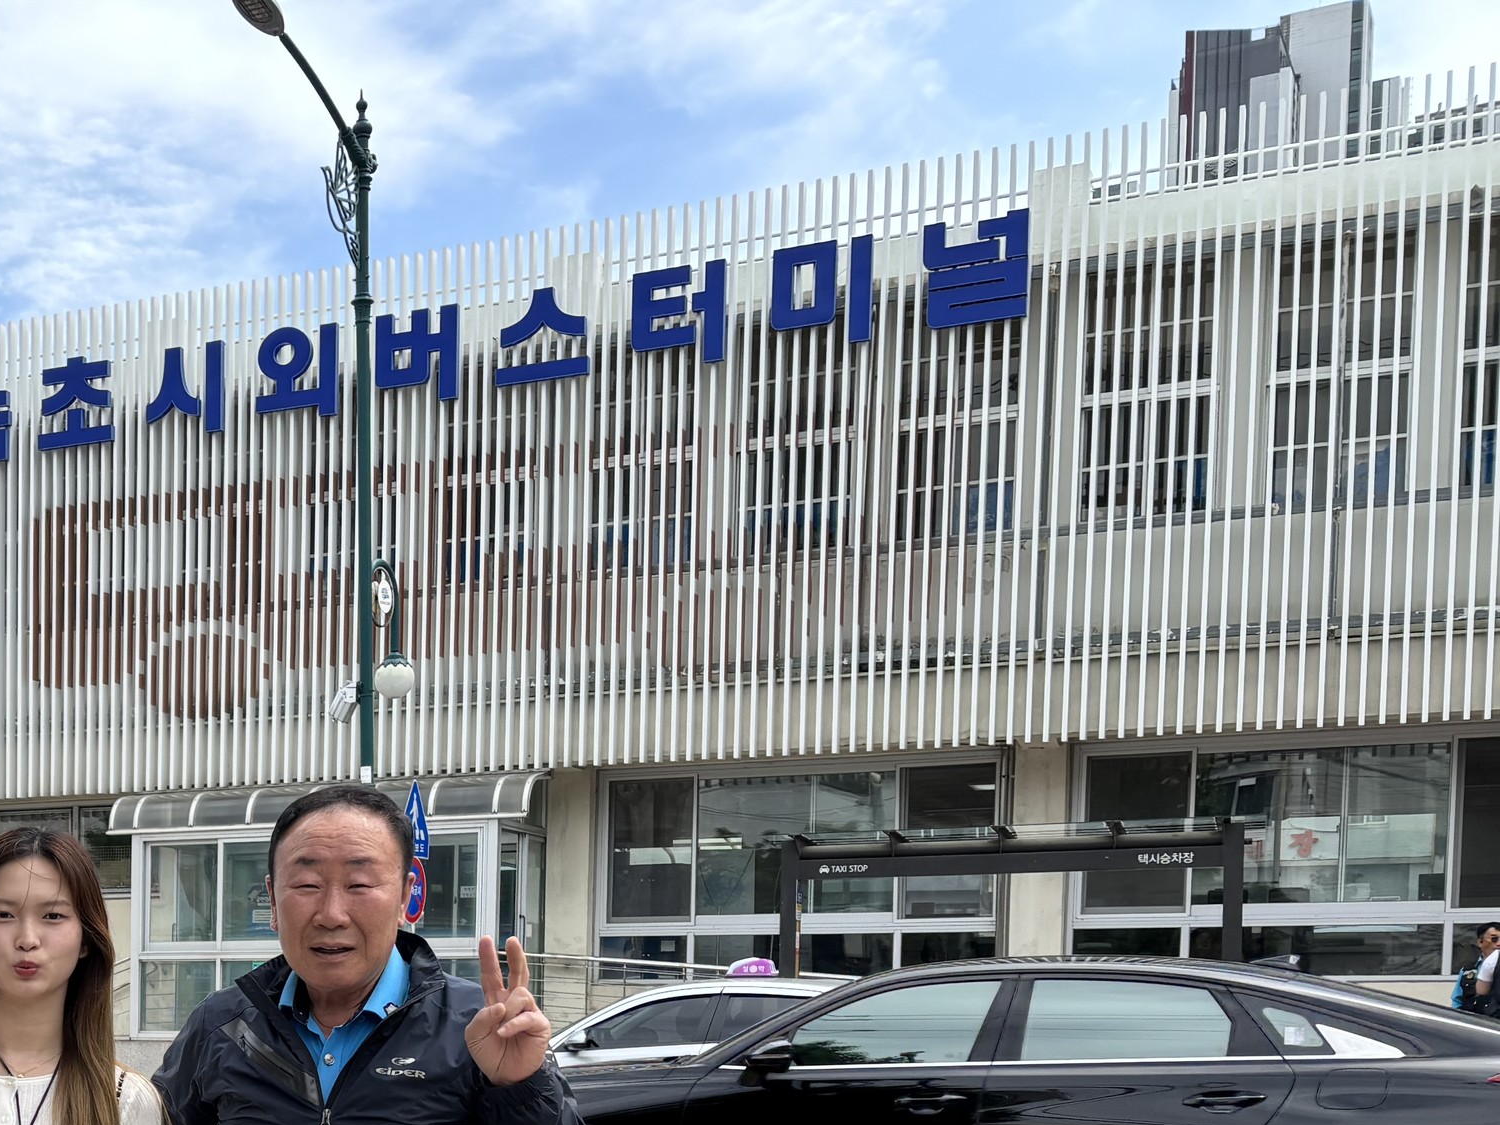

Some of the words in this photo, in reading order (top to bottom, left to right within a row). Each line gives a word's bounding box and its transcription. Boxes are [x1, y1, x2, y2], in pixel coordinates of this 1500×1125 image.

[1137, 851, 1195, 865] 택시승차장
[831, 865, 848, 873] TAXI
[848, 864, 869, 873] STOP
